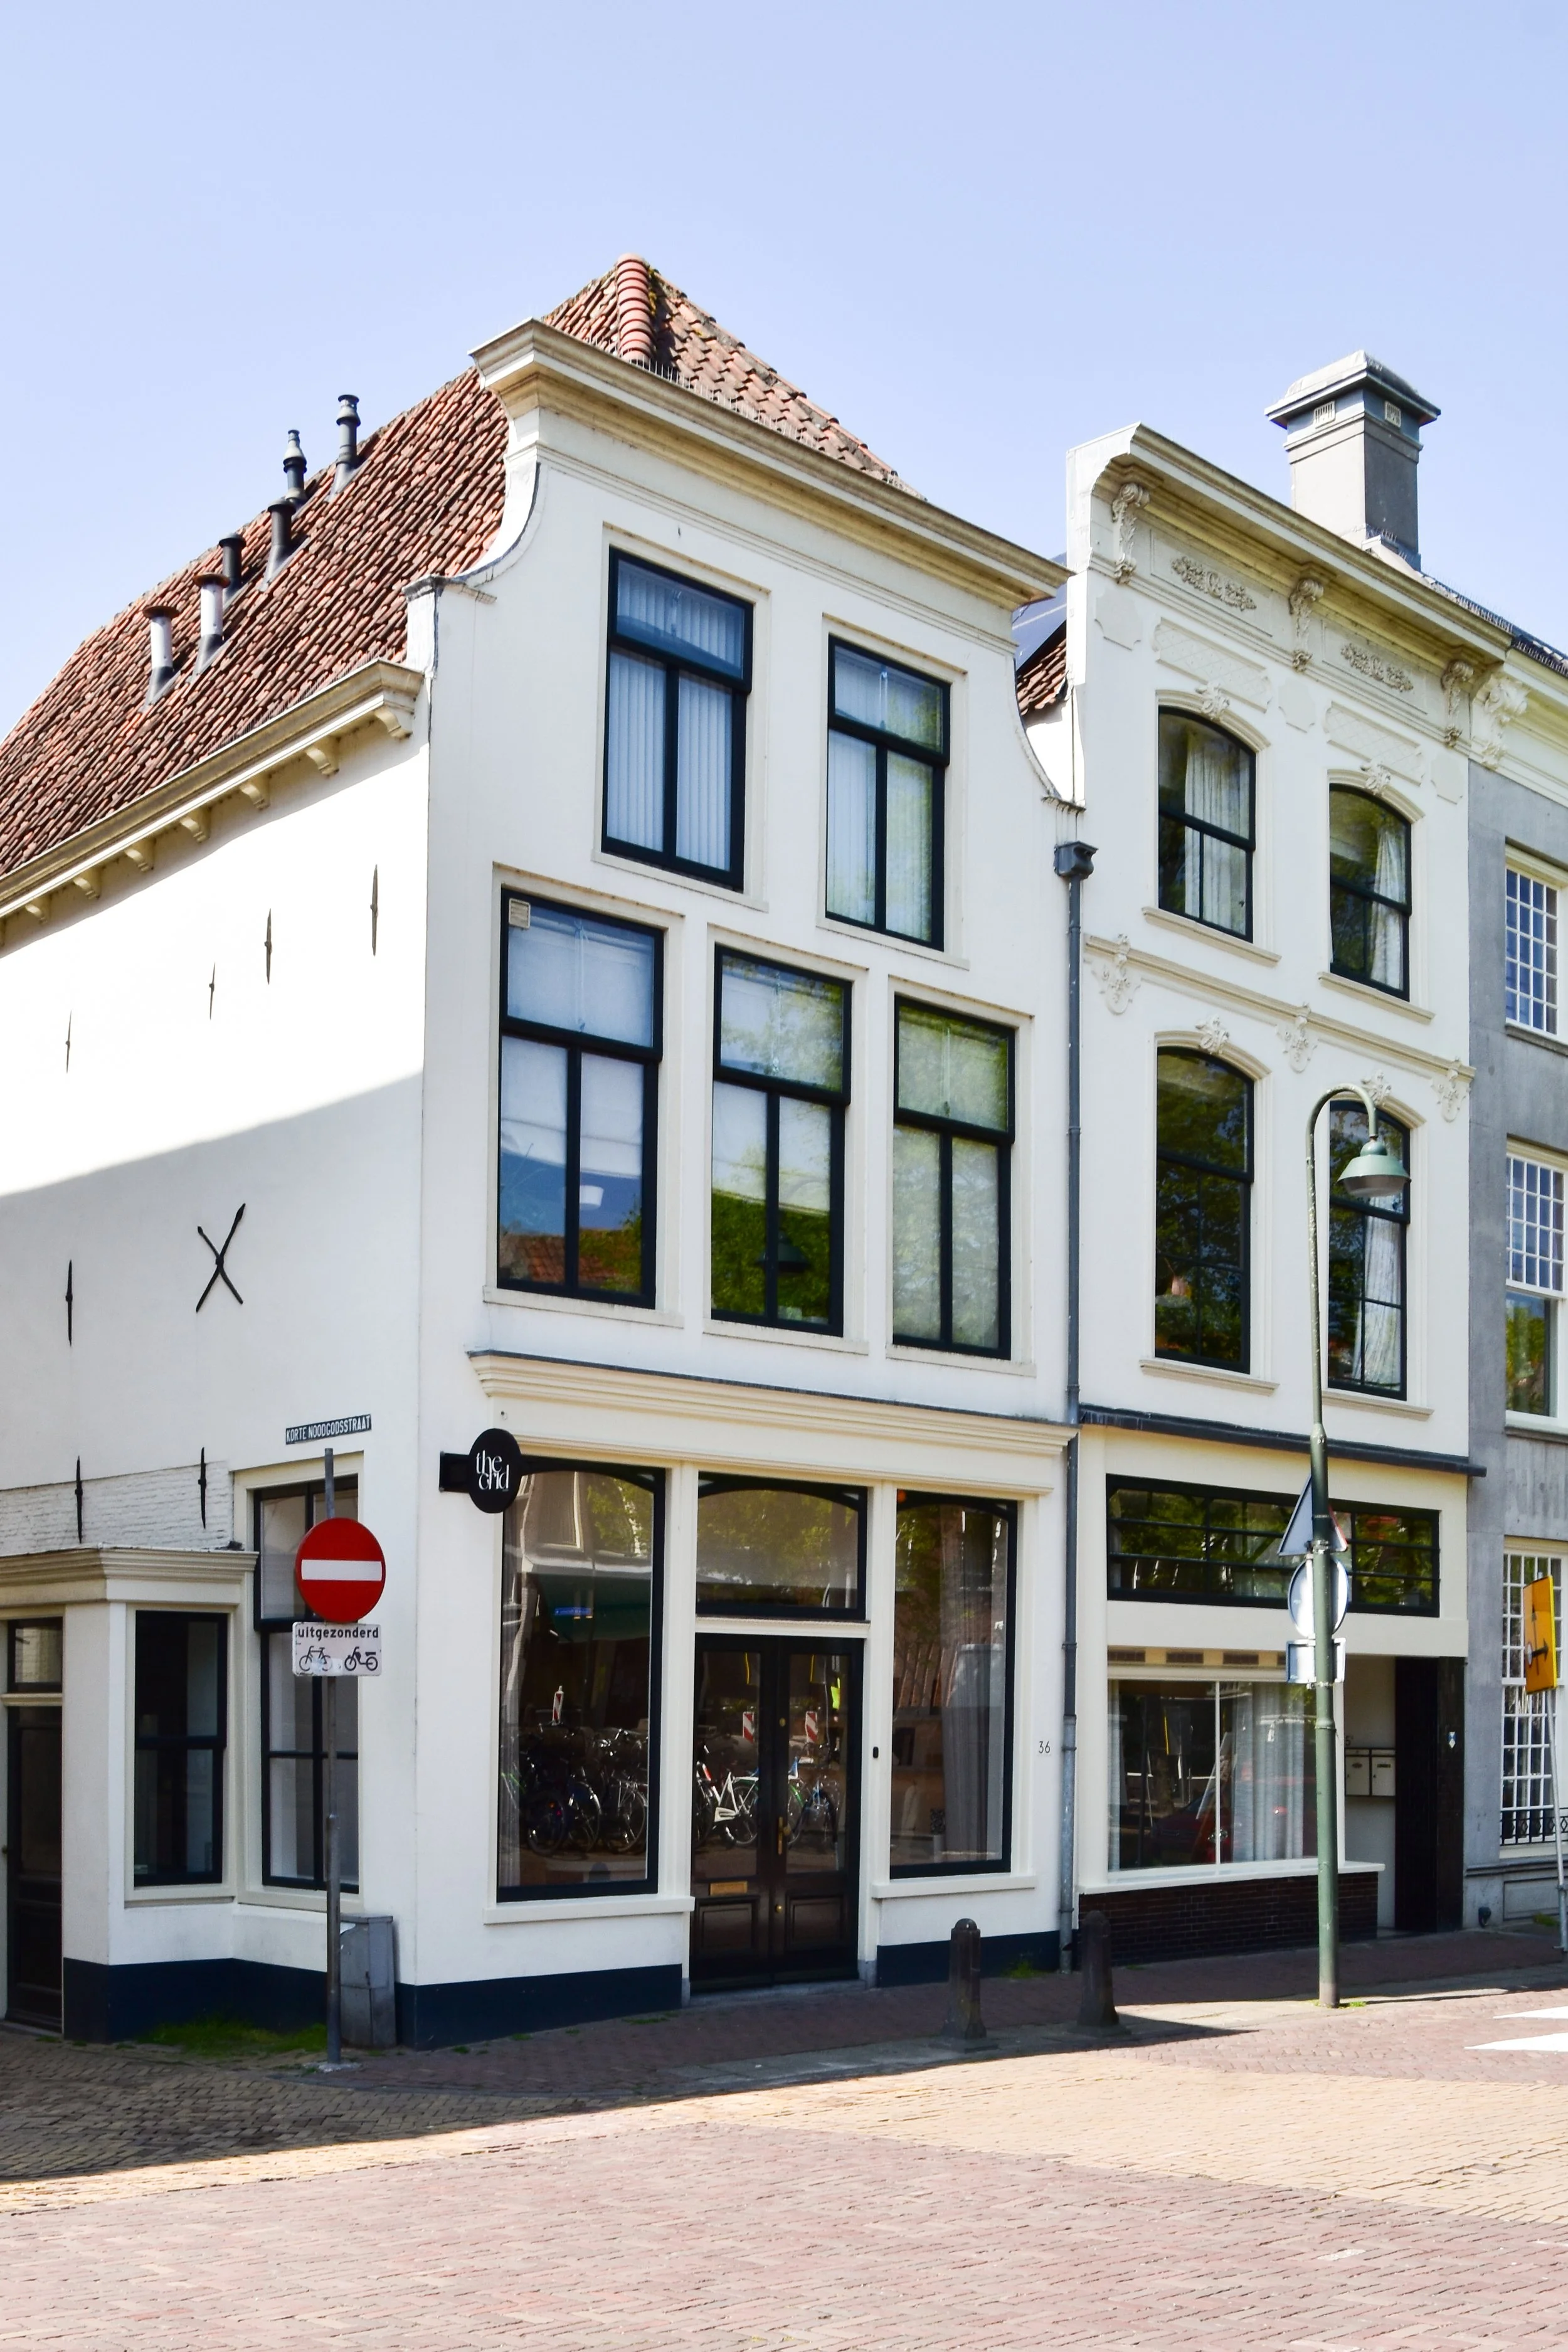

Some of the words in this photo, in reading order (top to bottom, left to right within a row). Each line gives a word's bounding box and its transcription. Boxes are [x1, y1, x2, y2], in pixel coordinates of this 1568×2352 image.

[287, 1428, 307, 1443] KORTE
[308, 1416, 370, 1438] NOODGODSSTRAAT
[476, 1449, 502, 1474] the
[298, 1626, 379, 1641] uitgezonderd
[1038, 1740, 1051, 1754] 36
